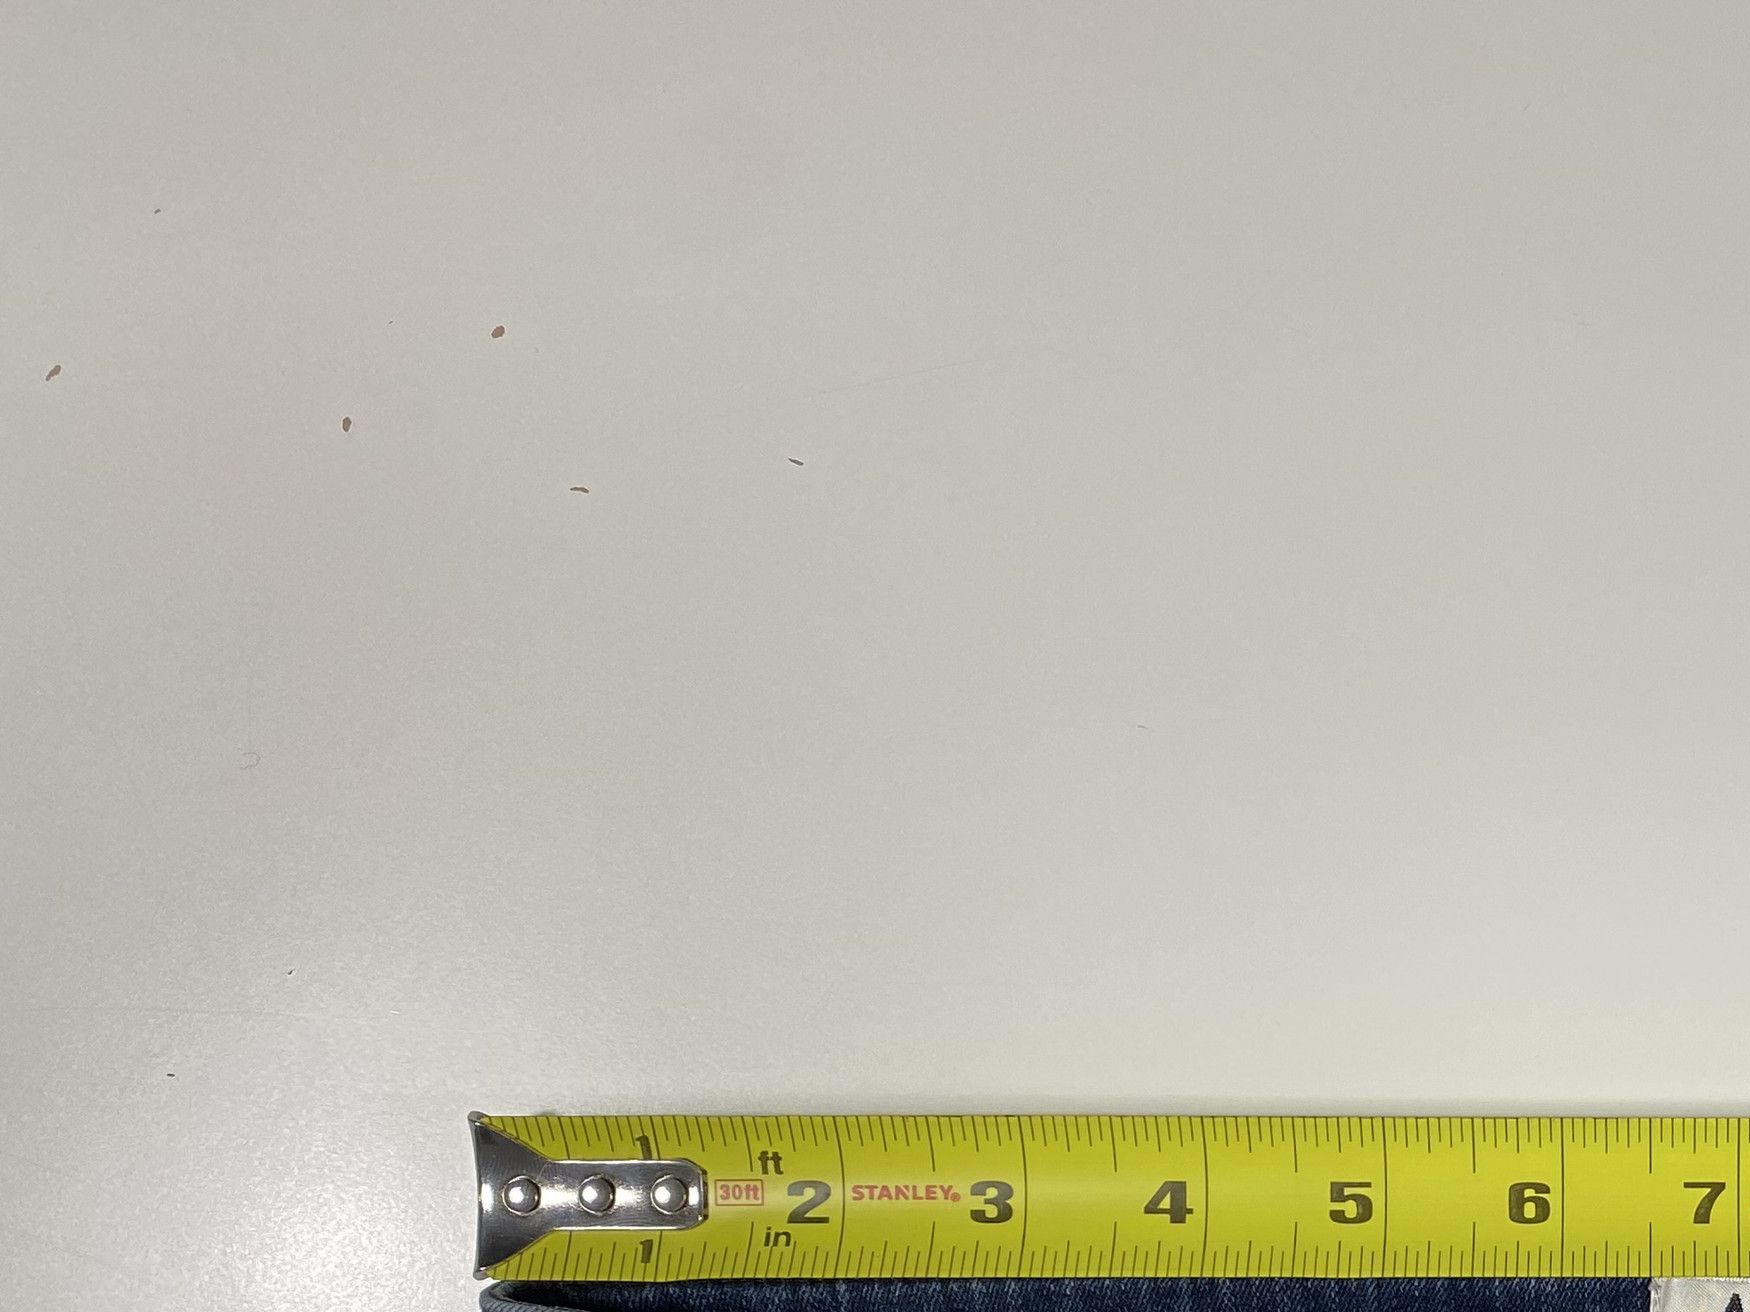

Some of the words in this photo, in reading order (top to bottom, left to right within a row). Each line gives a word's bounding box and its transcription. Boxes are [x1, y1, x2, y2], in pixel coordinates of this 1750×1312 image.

[634, 1135, 655, 1160] 1
[757, 1150, 784, 1175] ft
[719, 1183, 761, 1201] 30ft
[786, 1179, 832, 1225] 2
[969, 1180, 1015, 1224] 3
[1143, 1180, 1194, 1225] 4
[1328, 1181, 1374, 1225] 5
[1507, 1181, 1552, 1225] 6
[1682, 1181, 1727, 1225] 7
[639, 1238, 655, 1264] 1
[763, 1226, 792, 1248] in
